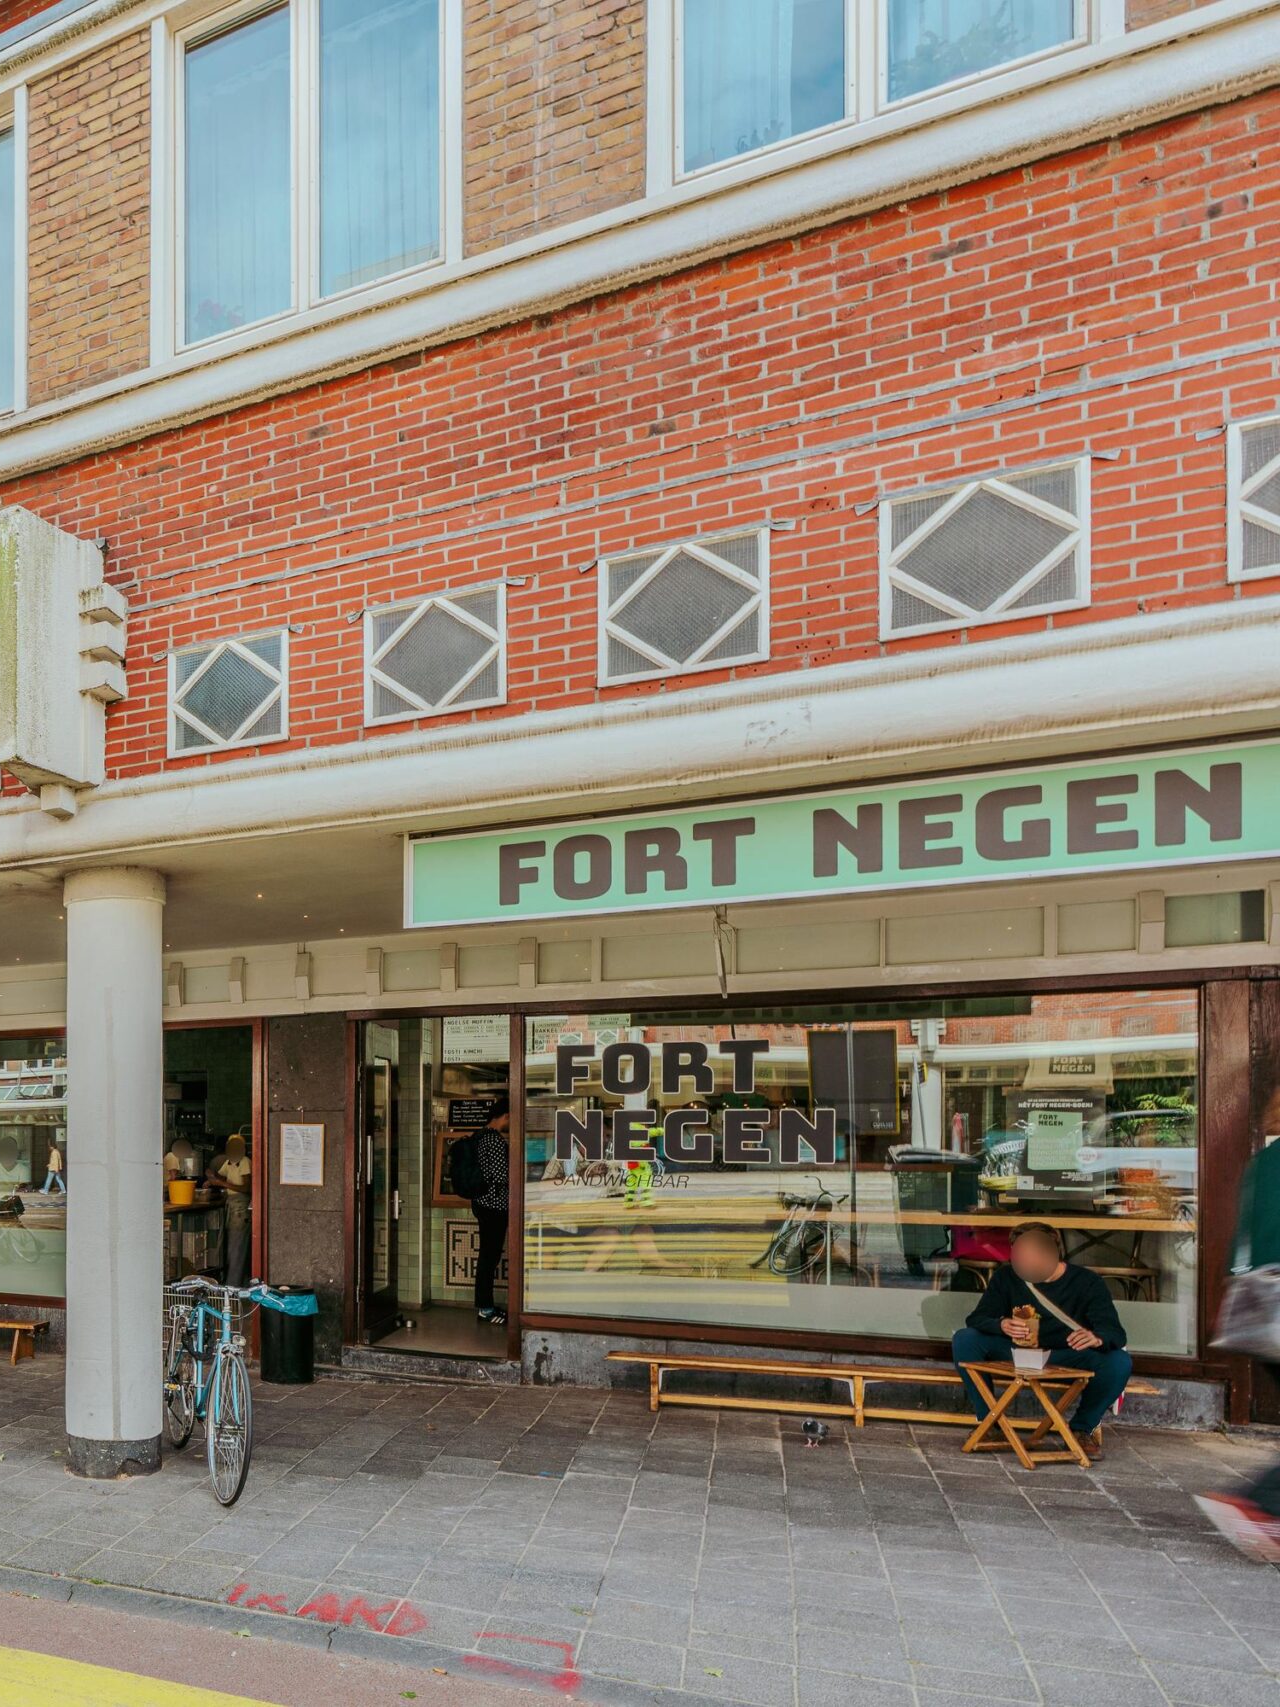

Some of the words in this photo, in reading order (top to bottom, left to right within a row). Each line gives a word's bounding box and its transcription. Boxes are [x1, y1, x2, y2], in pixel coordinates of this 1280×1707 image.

[498, 816, 756, 906] FORT
[812, 761, 1243, 878] NEGEN
[556, 1039, 770, 1095] FORT
[1052, 1064, 1092, 1072] NEGEN
[555, 1108, 836, 1165] NEGEN
[553, 1172, 690, 1188] SANDWICHBAR
